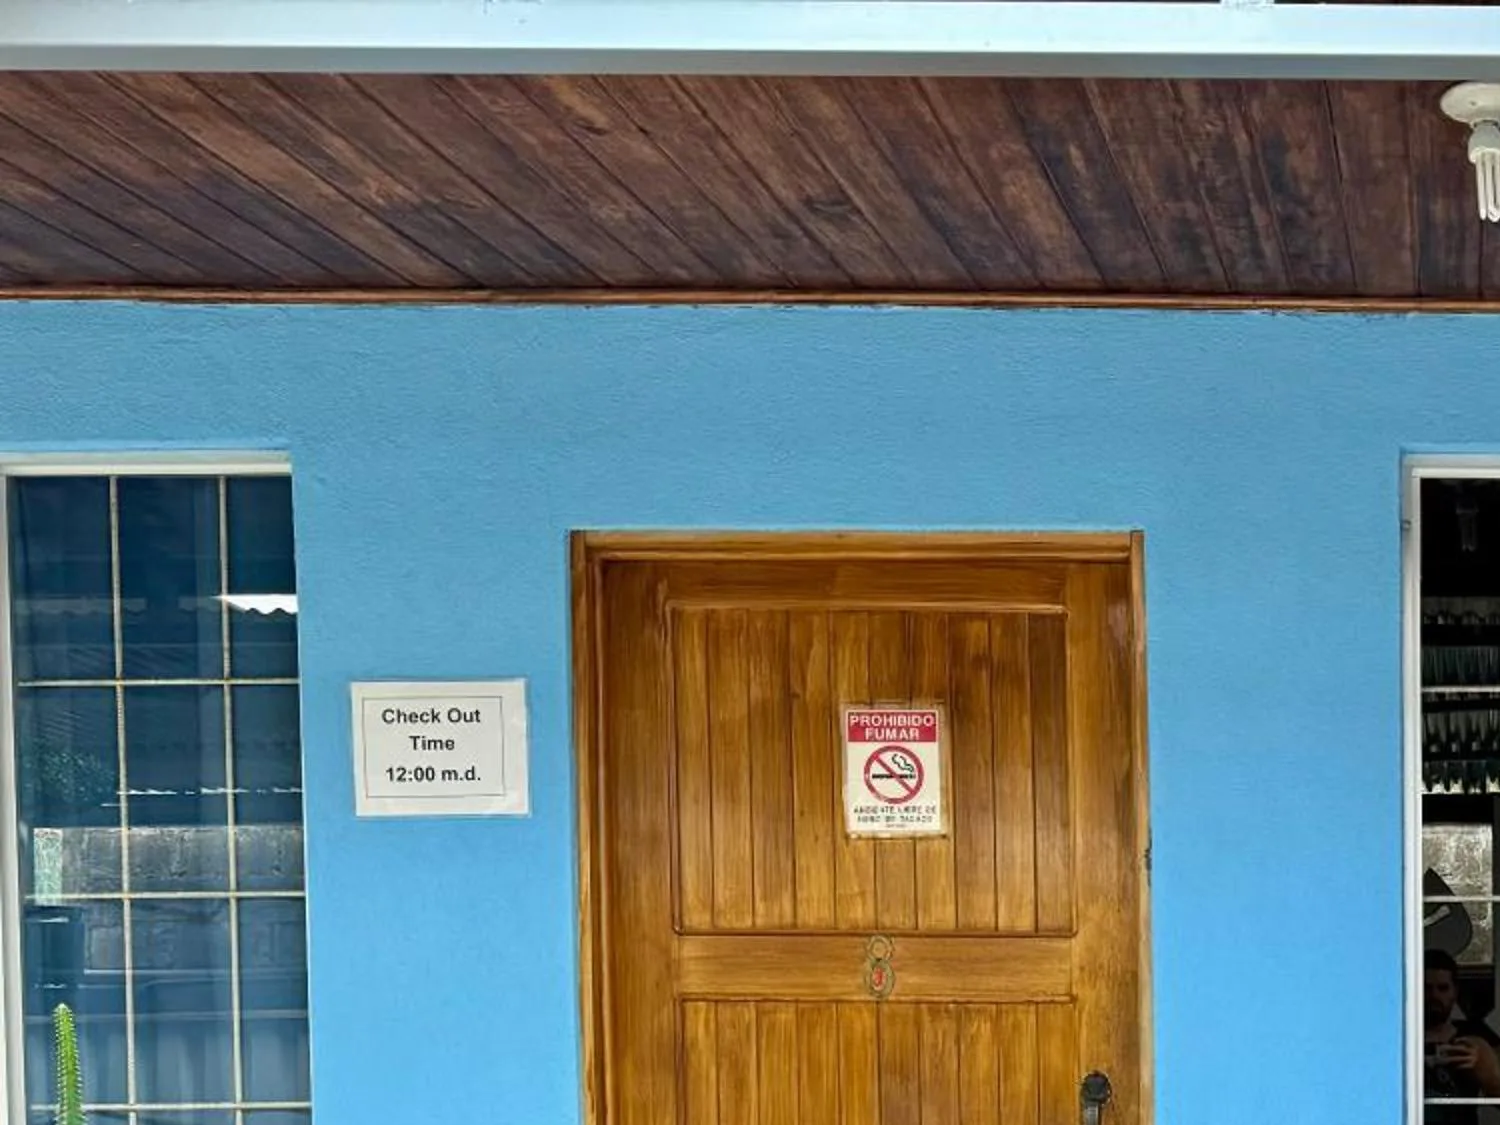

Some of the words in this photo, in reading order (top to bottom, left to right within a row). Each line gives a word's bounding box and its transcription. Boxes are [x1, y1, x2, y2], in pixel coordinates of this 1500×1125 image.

[381, 708, 441, 724] Check
[447, 708, 481, 723] Out
[849, 714, 935, 727] PROHIBIDO
[865, 727, 920, 740] FUMAR
[409, 736, 455, 751] Time
[386, 767, 436, 782] 12:00
[441, 766, 481, 782] m.d.
